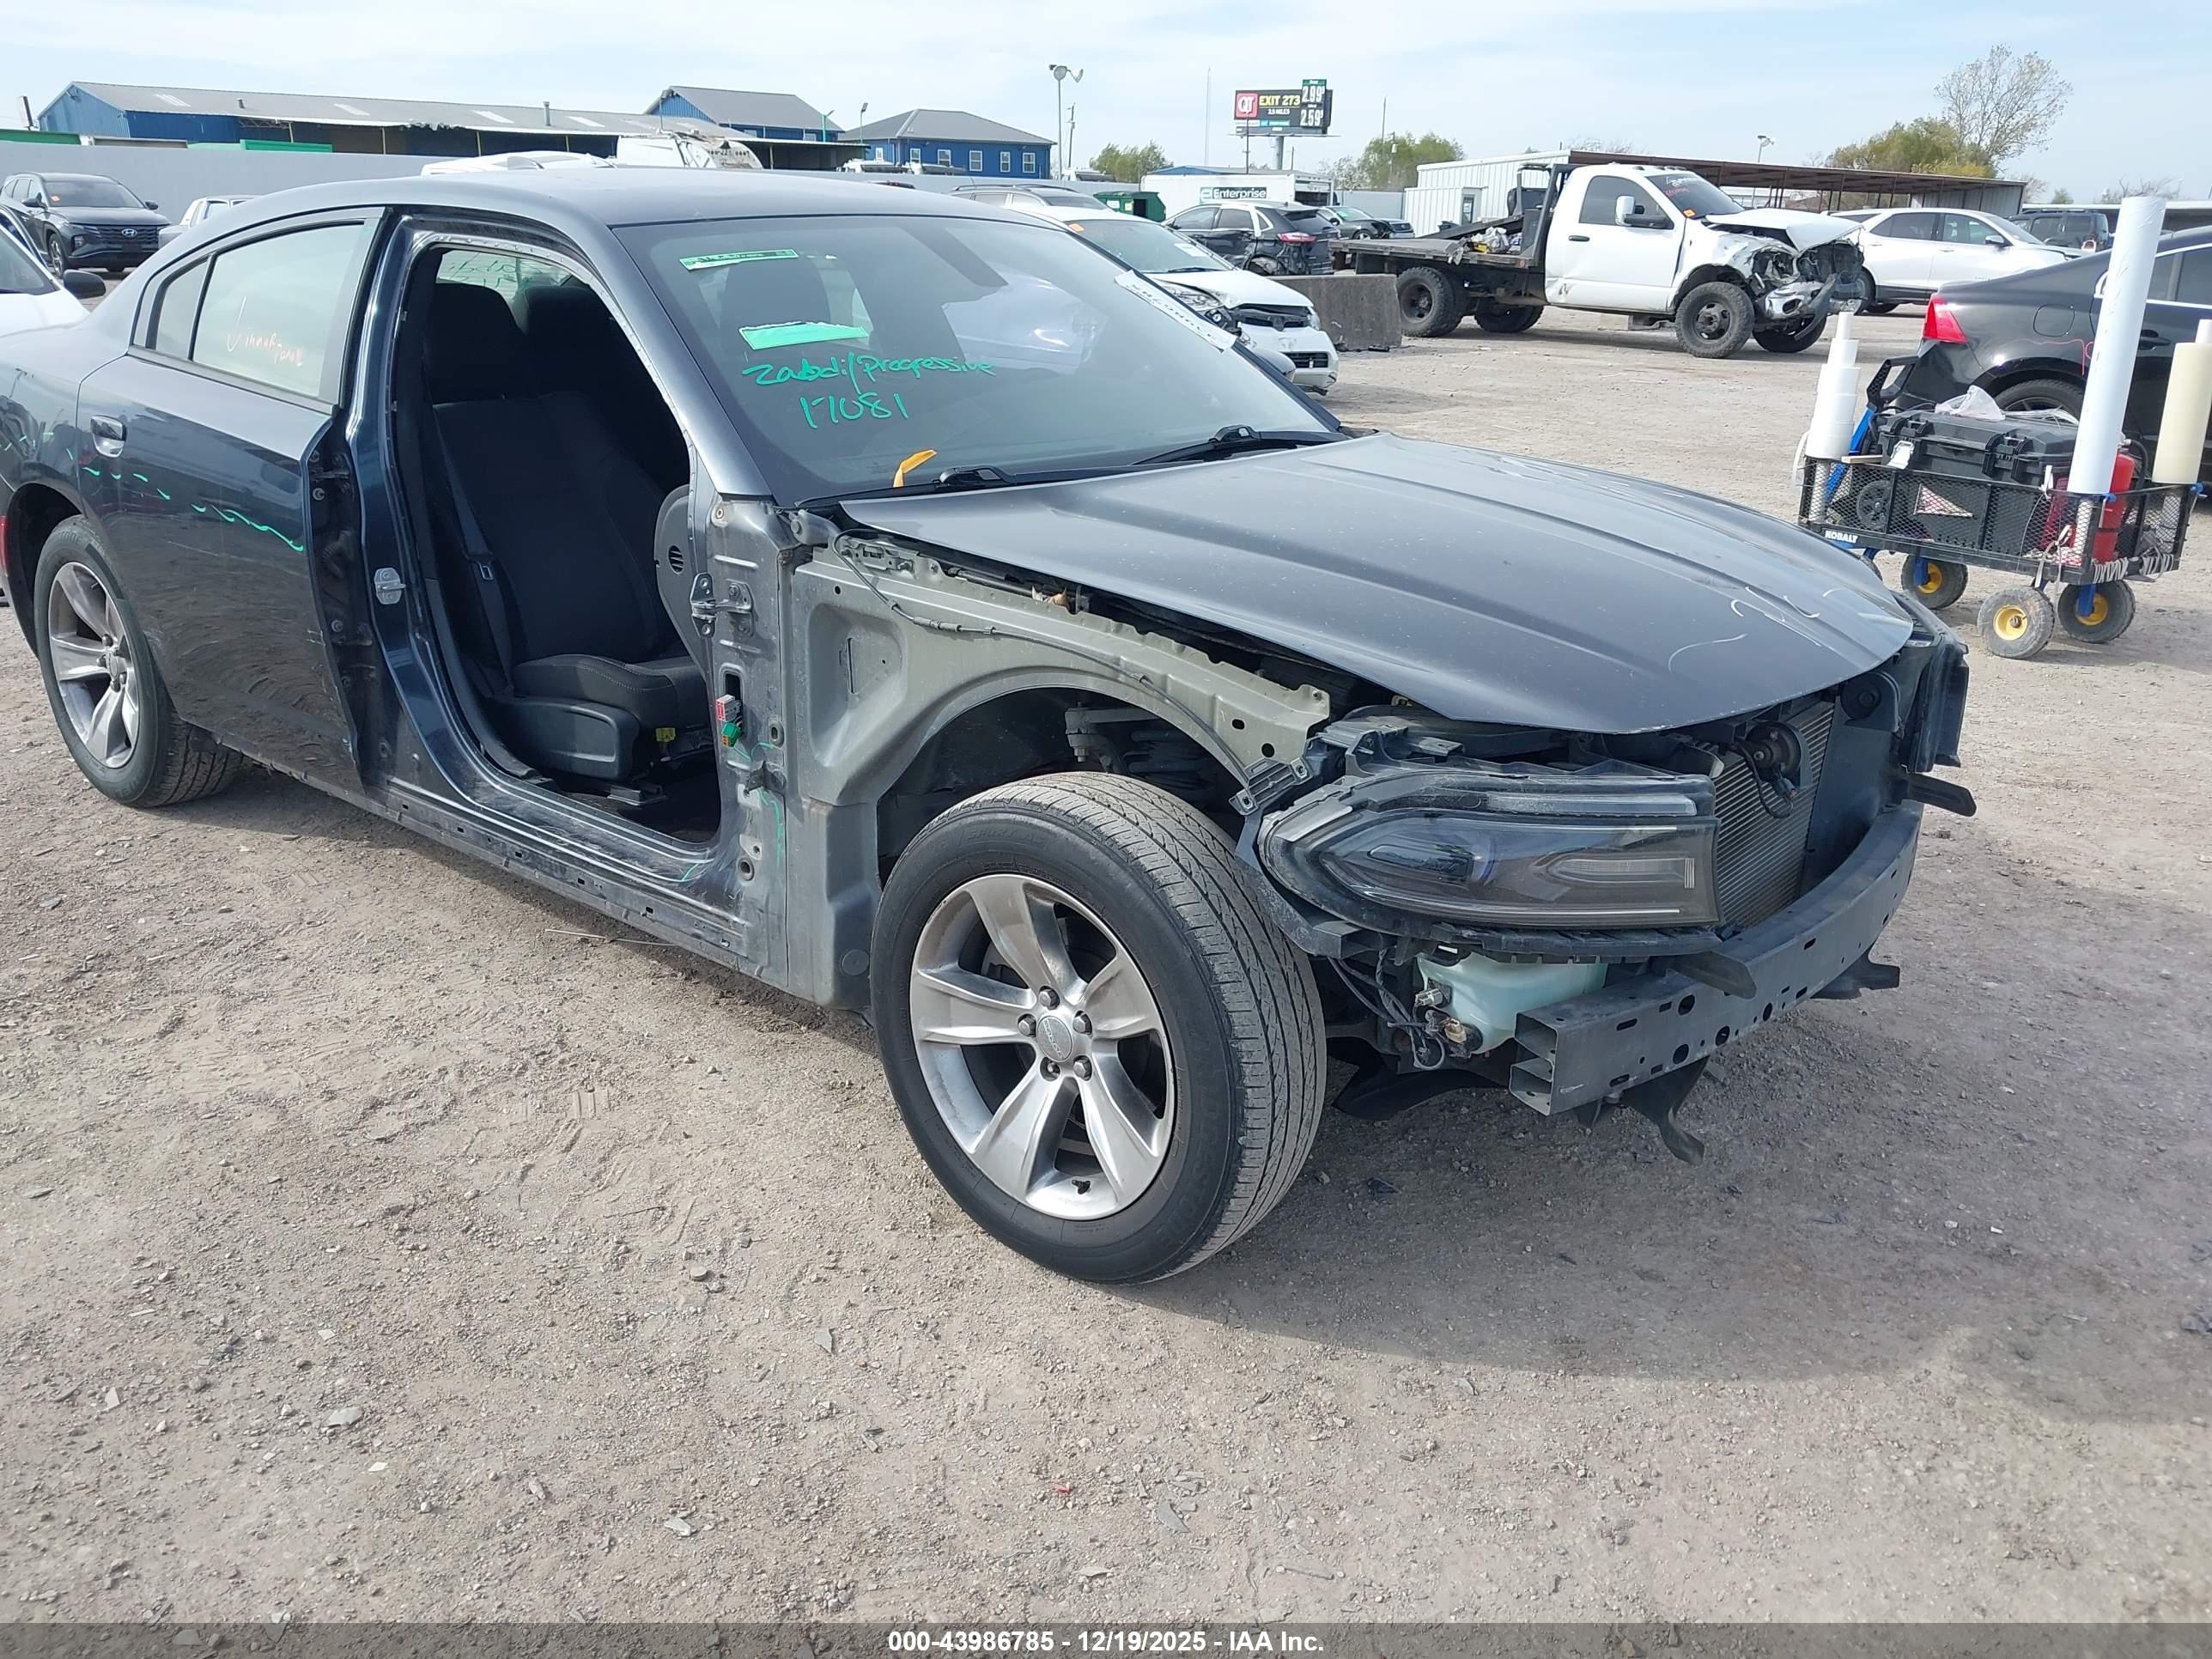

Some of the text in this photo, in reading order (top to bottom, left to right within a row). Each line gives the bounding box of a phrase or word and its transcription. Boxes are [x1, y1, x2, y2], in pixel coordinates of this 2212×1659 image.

[1238, 96, 1255, 114] QT
[1259, 95, 1301, 106] EXIT 273
[1213, 188, 1267, 199] Enterprise
[800, 392, 908, 428] 17081
[1825, 530, 1858, 543] KOBALT
